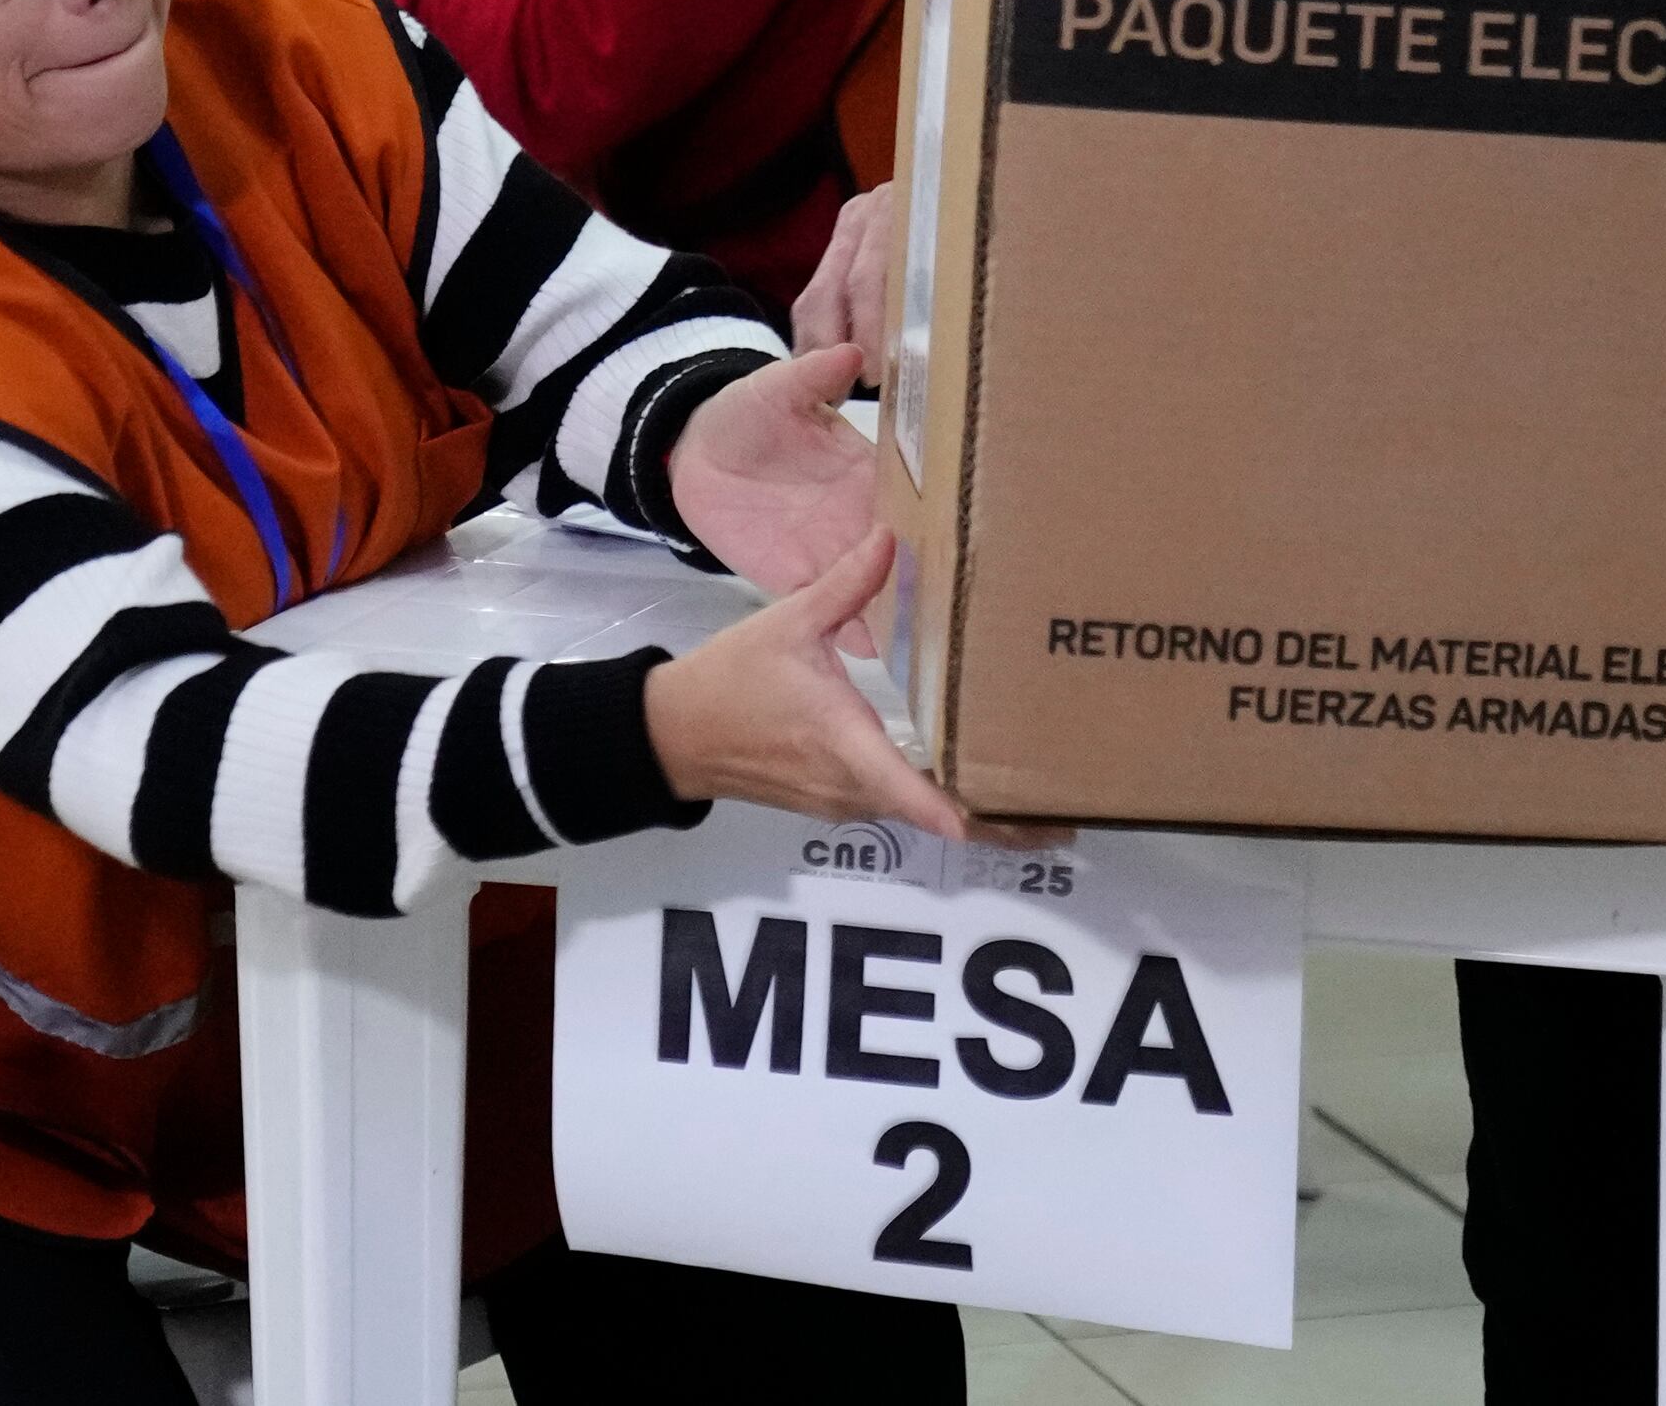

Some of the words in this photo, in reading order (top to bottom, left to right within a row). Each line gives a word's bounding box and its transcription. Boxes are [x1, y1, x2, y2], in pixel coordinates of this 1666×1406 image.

[1047, 618, 1264, 667] RETORNO
[1276, 630, 1359, 671] DEL
[1371, 637, 1592, 682] MATERIAL
[1229, 685, 1436, 731] FUERZAS
[658, 908, 1233, 1116] MESA
[873, 1121, 973, 1271] 2
